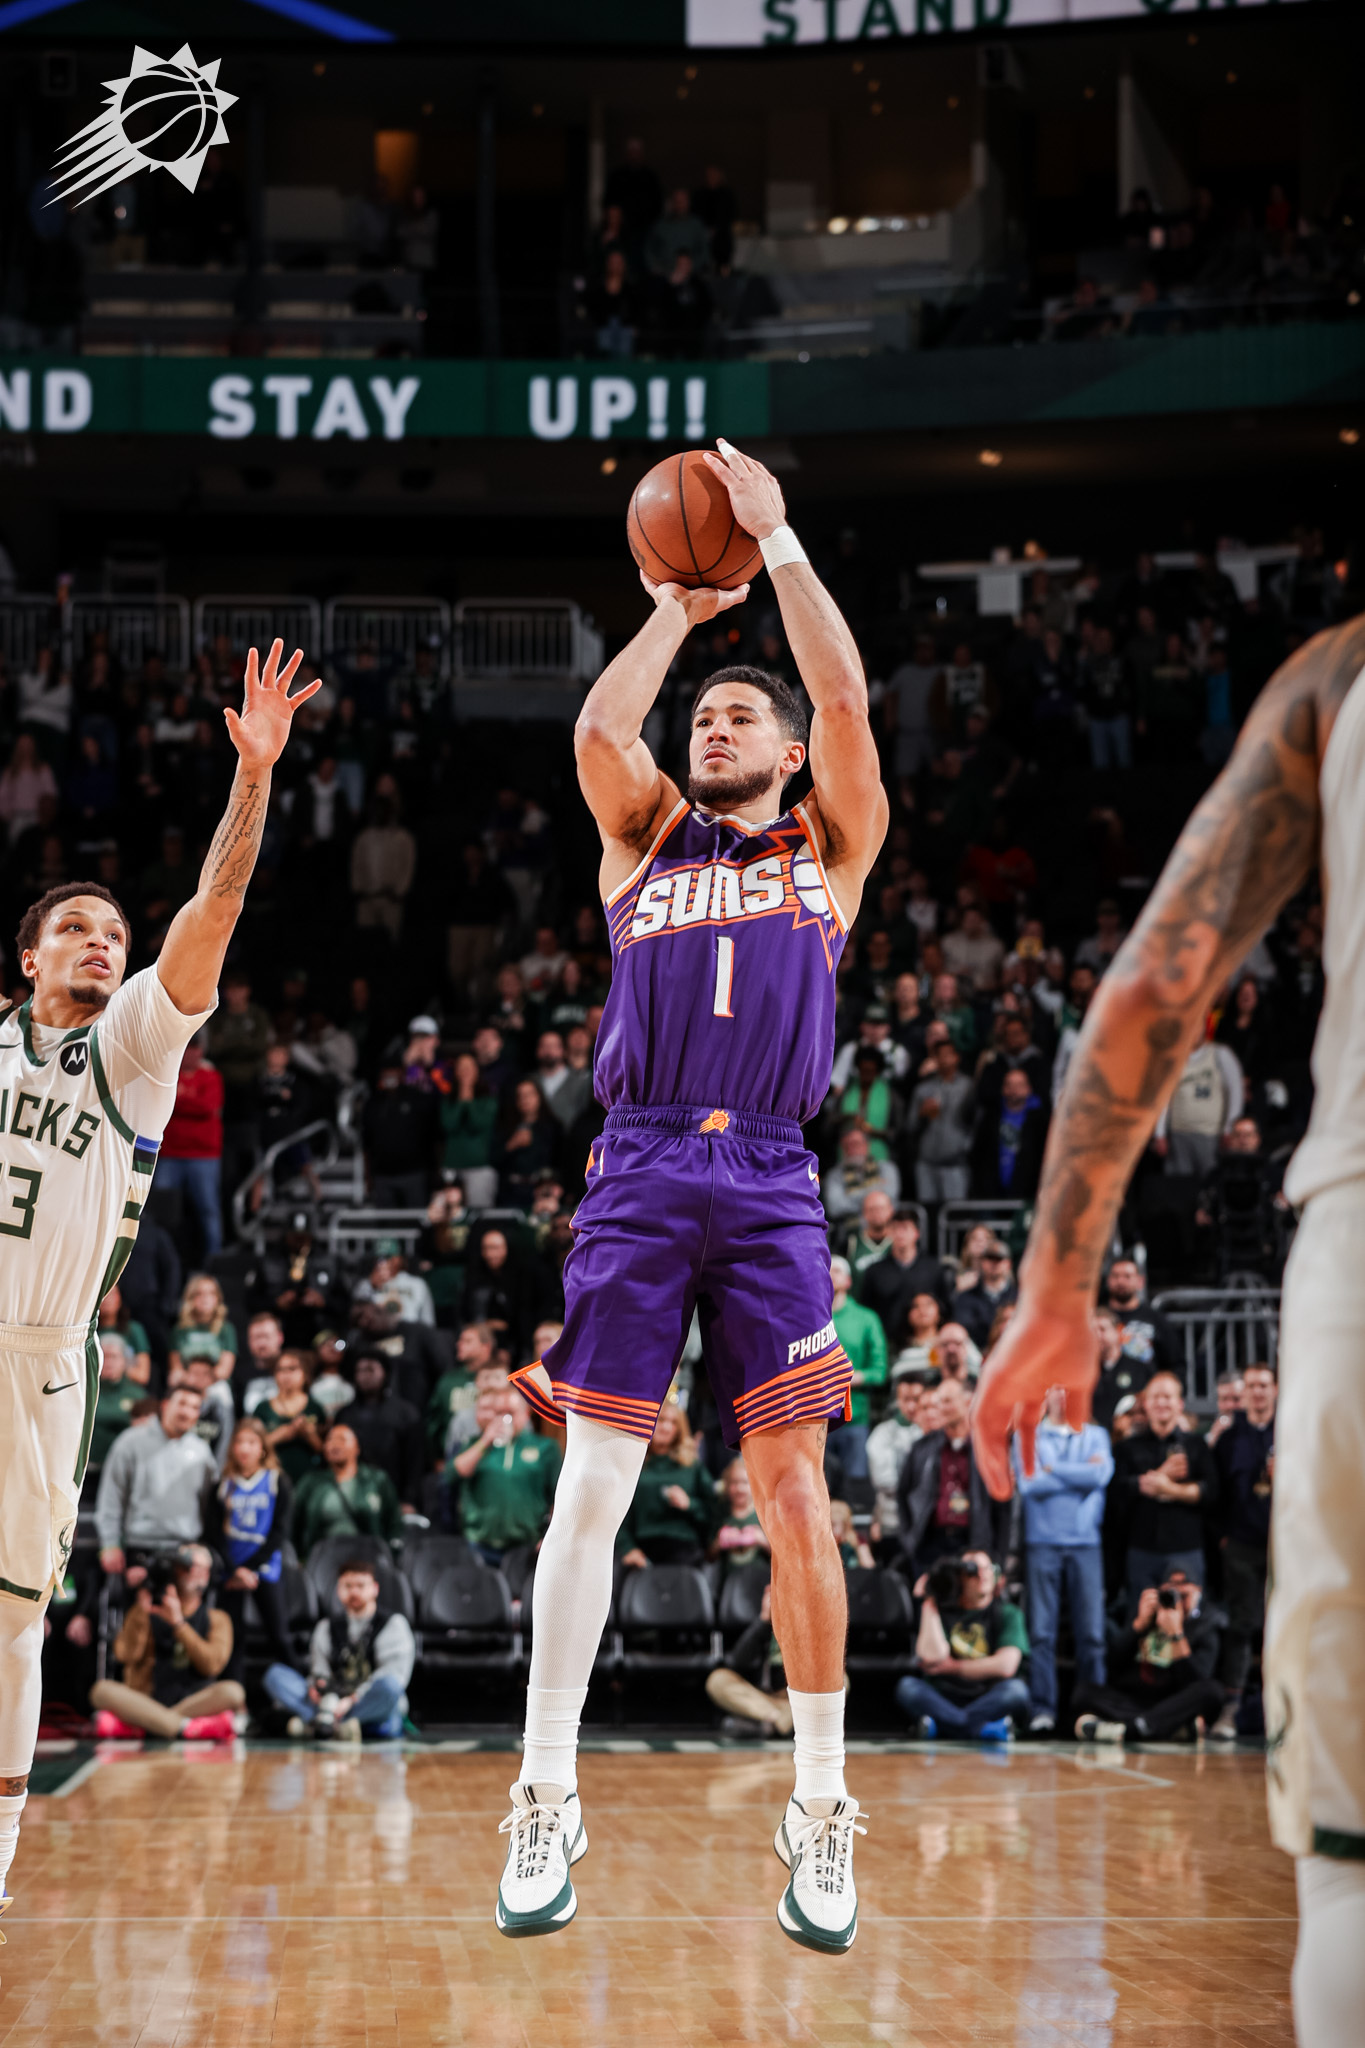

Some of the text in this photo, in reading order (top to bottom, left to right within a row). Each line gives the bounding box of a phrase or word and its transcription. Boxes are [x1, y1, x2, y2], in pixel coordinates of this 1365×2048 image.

[208, 374, 421, 440] STAY
[529, 375, 706, 440] UP!!
[631, 856, 785, 939] SUNS
[713, 936, 735, 1018] 1
[0, 1164, 43, 1240] 3
